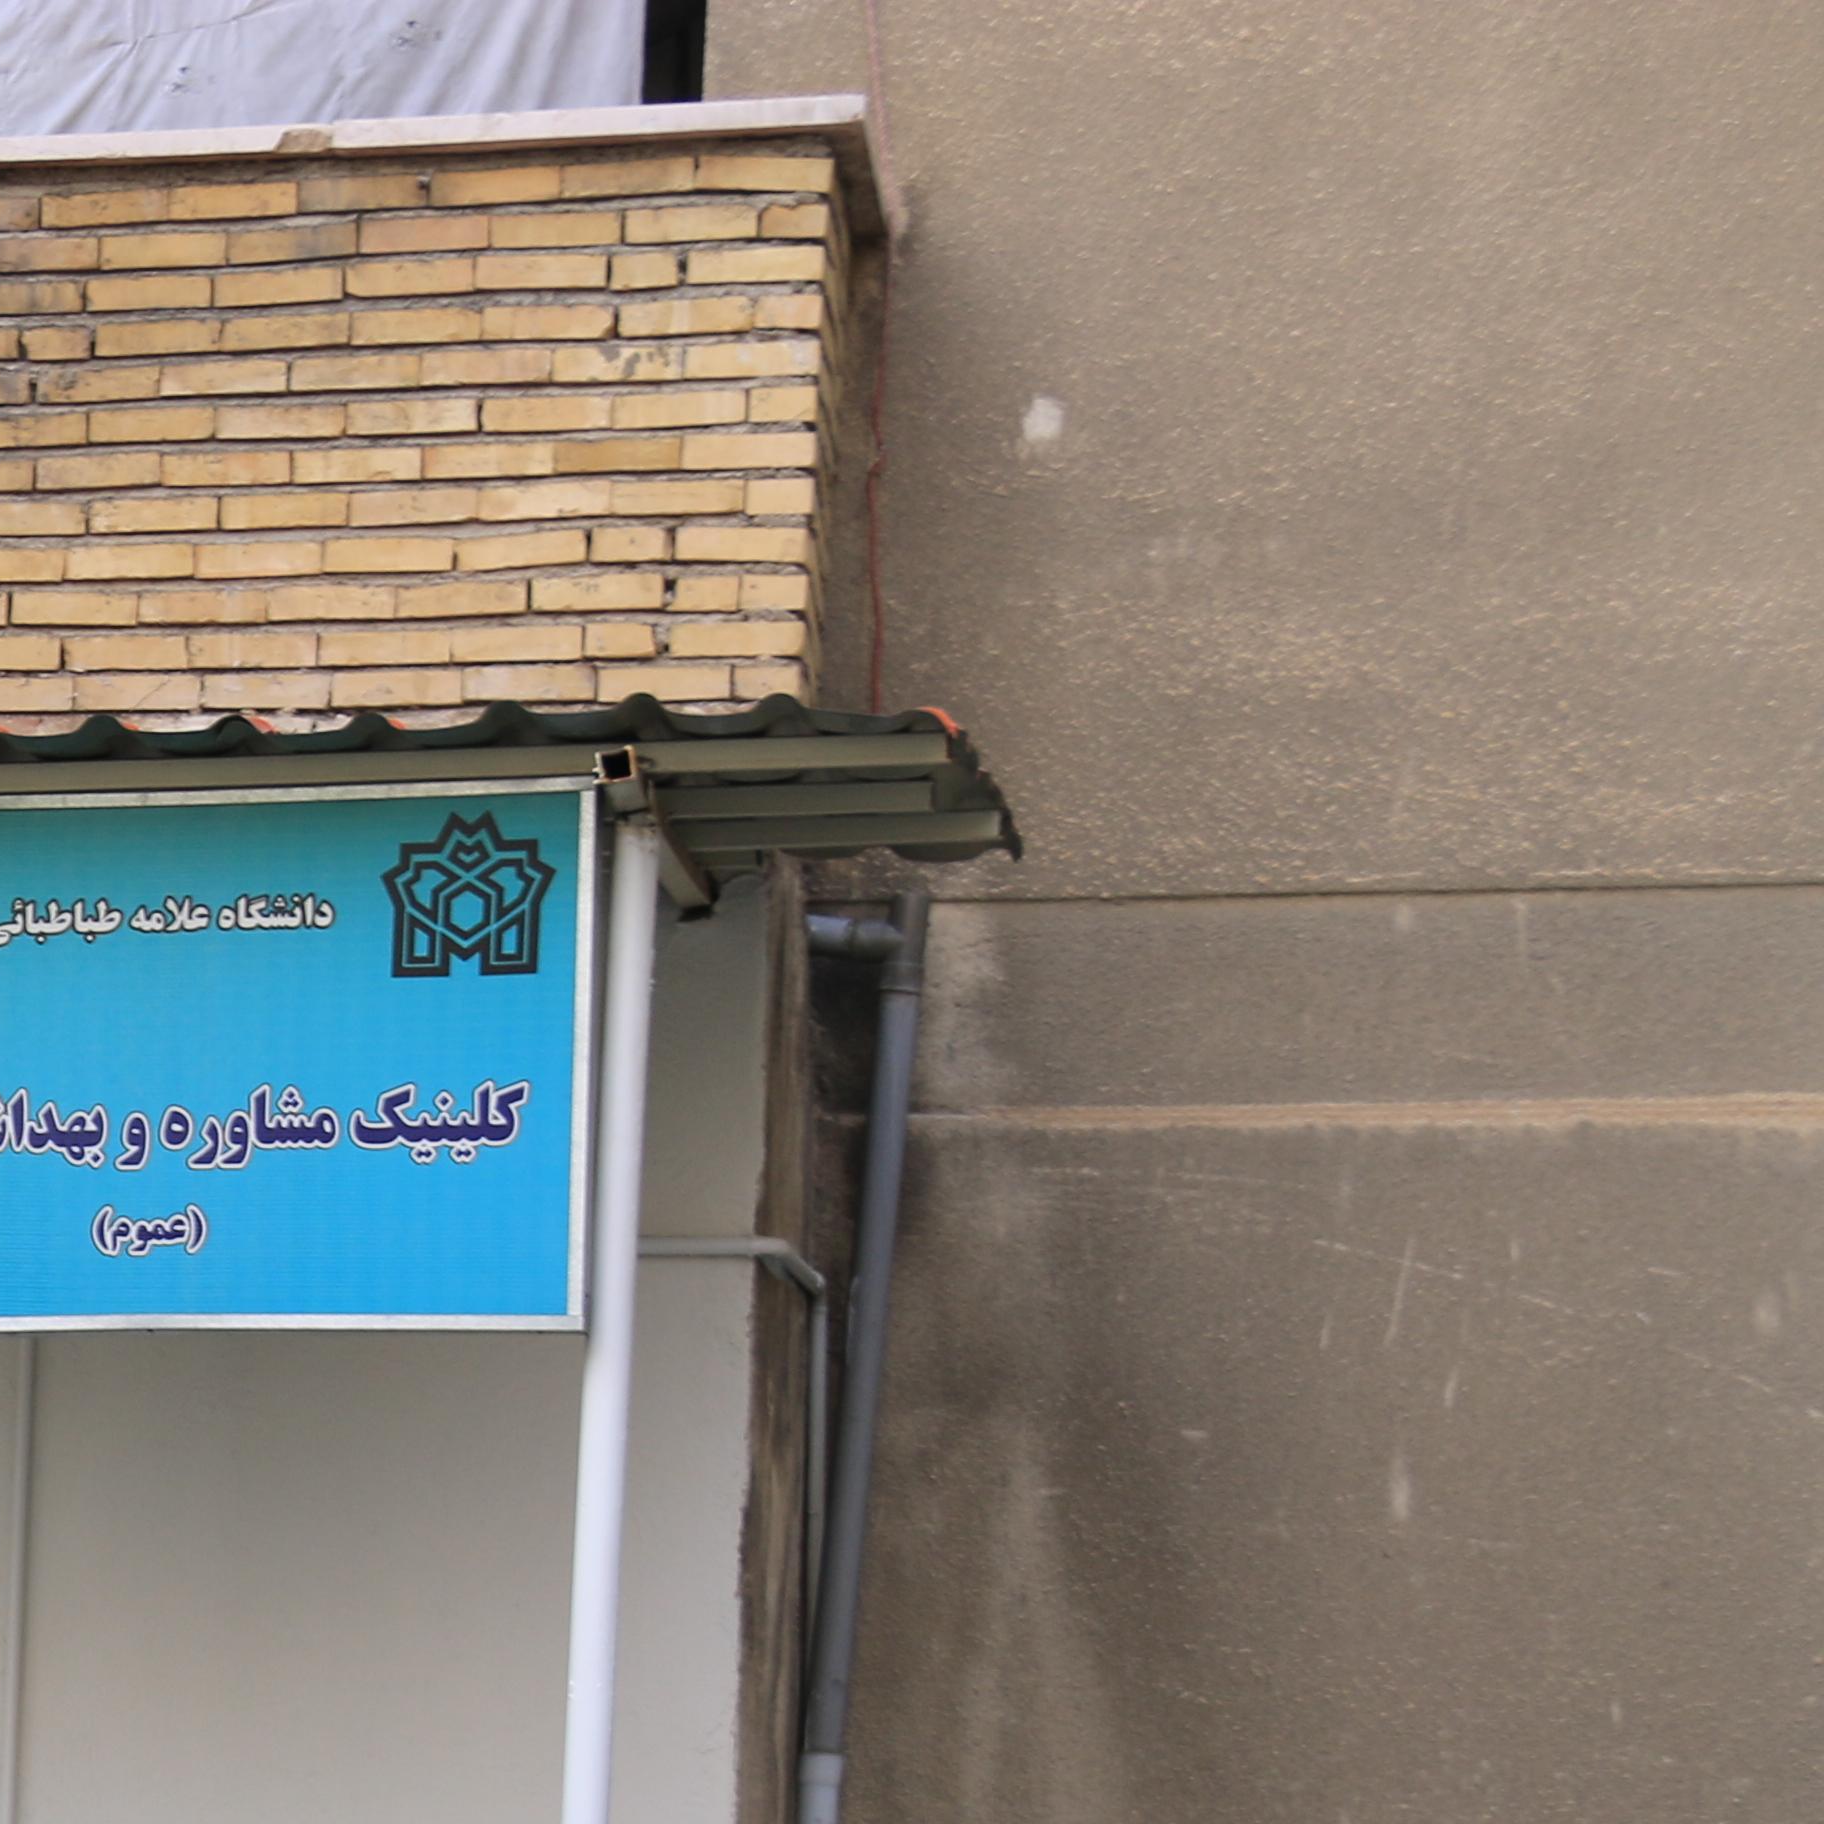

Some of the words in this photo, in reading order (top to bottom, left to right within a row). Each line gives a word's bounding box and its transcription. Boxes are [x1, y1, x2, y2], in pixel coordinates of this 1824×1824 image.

[129, 895, 212, 933] علامه
[217, 891, 335, 930] دانشگاه
[116, 1110, 151, 1170] و
[159, 1082, 339, 1170] مشاوره
[351, 1080, 530, 1164] کلینیک
[91, 1203, 208, 1257] (عموم)
